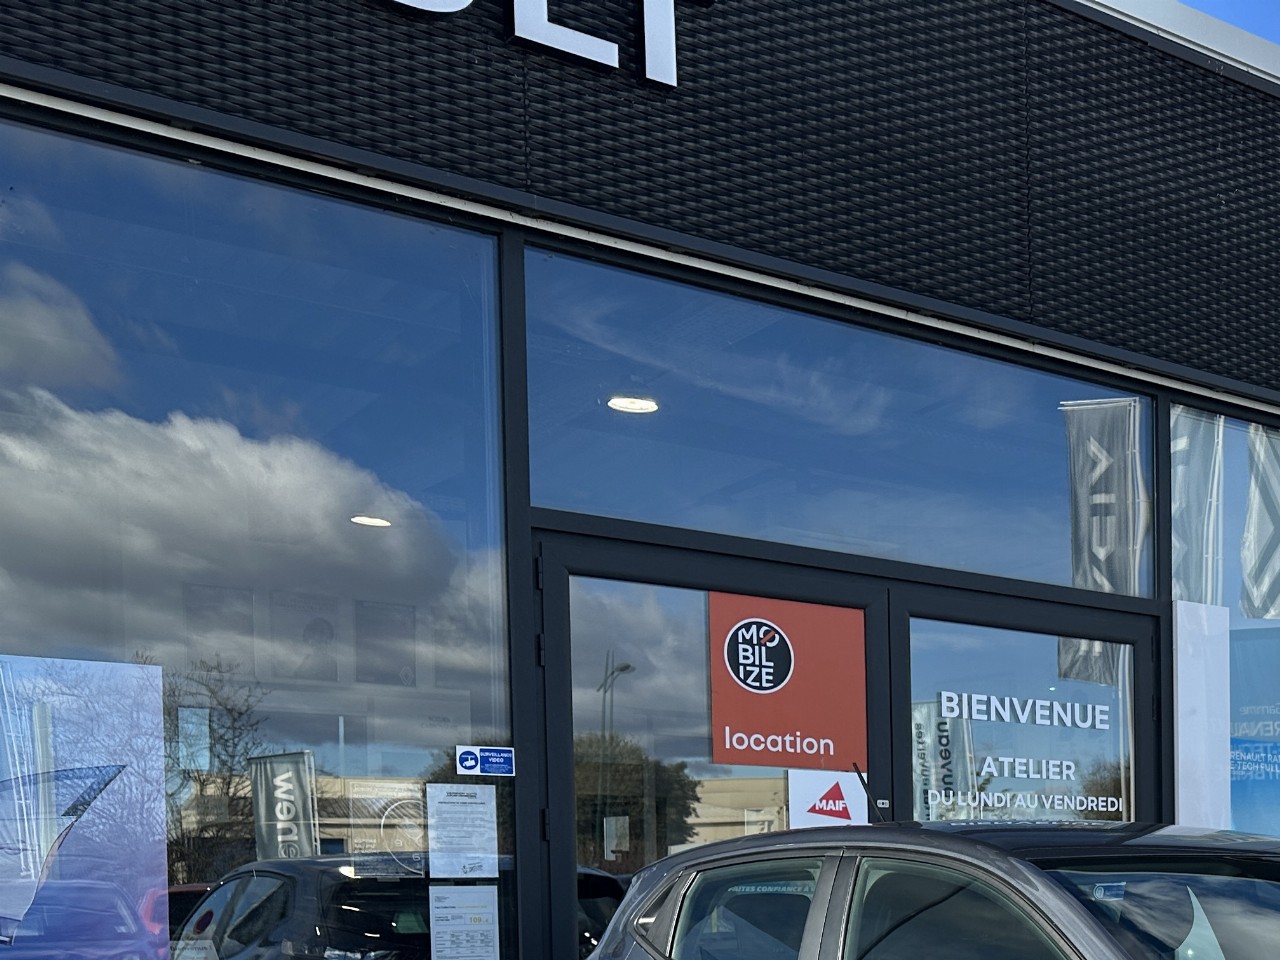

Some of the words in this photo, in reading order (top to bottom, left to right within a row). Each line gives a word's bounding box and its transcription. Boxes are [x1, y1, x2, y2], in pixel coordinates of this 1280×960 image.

[941, 690, 1110, 730] BIENVENUE
[724, 725, 835, 756] location
[981, 755, 1076, 780] ATELIER
[815, 799, 847, 812] MAIF
[927, 789, 954, 805] DU
[957, 790, 1011, 808] LUNDI
[1013, 794, 1039, 809] AU
[1041, 795, 1123, 812] VENDREDI
